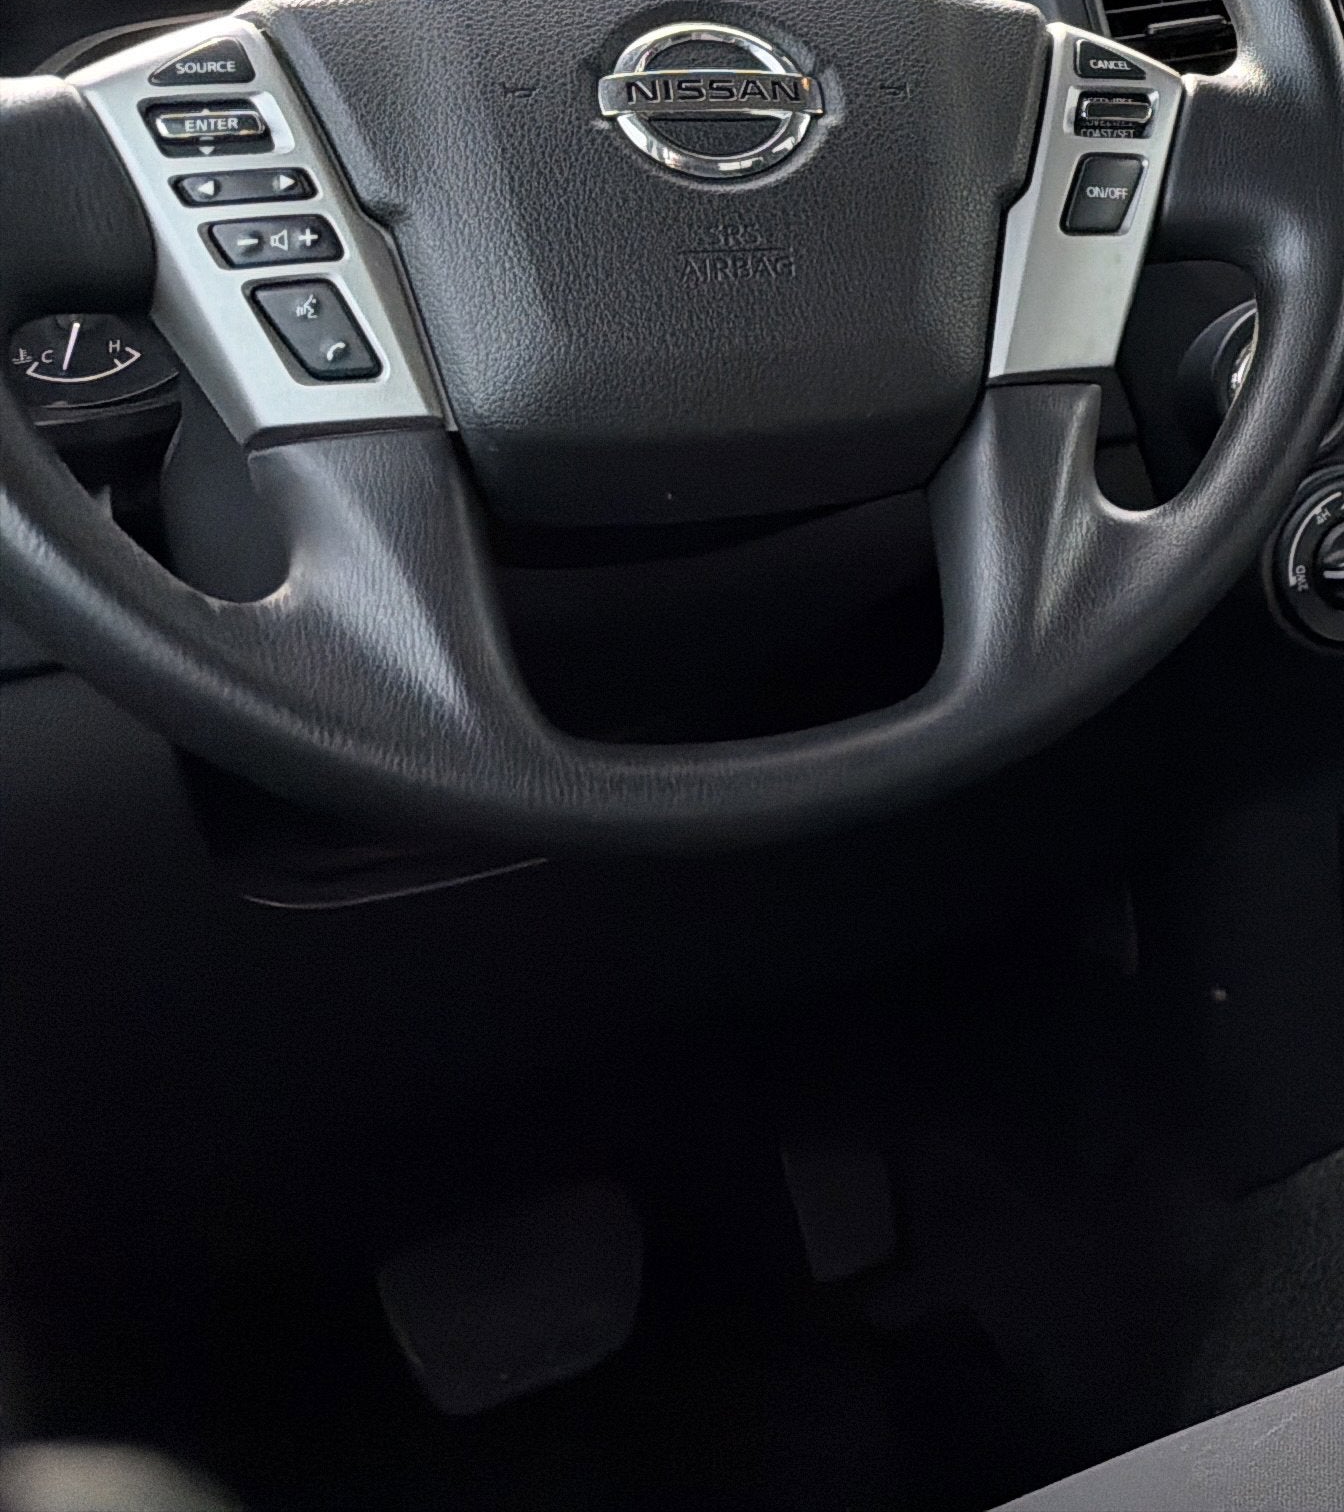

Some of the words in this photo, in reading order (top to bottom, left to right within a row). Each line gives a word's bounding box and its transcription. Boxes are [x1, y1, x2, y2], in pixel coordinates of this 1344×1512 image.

[176, 59, 235, 74] SOURCE
[1089, 58, 1130, 71] CANCEL
[627, 78, 802, 106] NISSAN
[184, 117, 238, 133] ENTER
[1086, 186, 1129, 200] ON/OFF
[680, 255, 797, 284] AIRBAG
[108, 339, 121, 353] H
[41, 349, 54, 363] C
[1316, 508, 1331, 525] 4H
